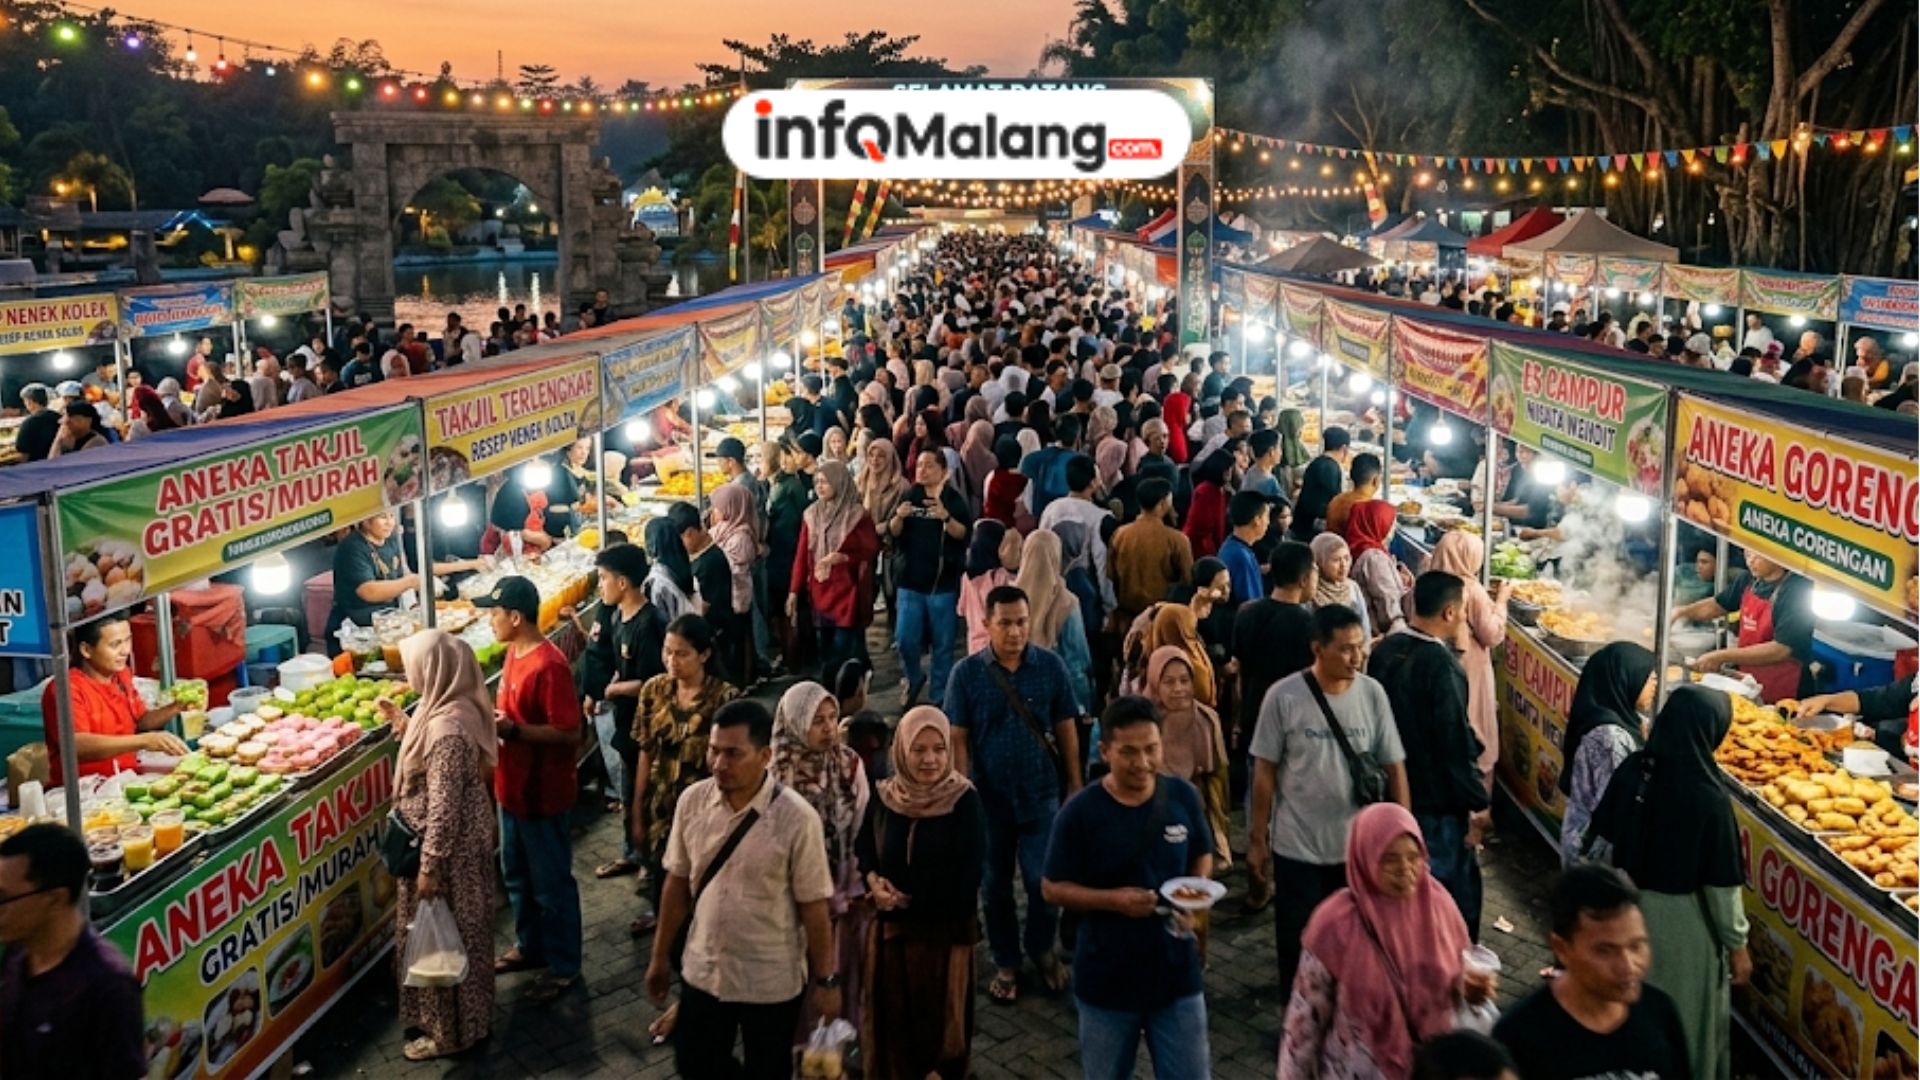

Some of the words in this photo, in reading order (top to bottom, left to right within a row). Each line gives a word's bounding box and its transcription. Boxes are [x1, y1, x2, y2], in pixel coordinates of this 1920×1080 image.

[435, 395, 498, 437] TAKJIL
[1546, 367, 1626, 423] CAMPUR
[158, 456, 270, 513] ANEKA
[275, 427, 366, 476] TAKJIL
[1688, 414, 1777, 490] ANEKA
[144, 458, 380, 557] GRATIS/MURAH
[1742, 508, 1790, 541] ANEKA
[1793, 527, 1887, 584] GORENGAN
[135, 838, 285, 984] ANEKA
[291, 756, 394, 863] TAKJIL
[200, 821, 381, 984] GRATIS/MURAH
